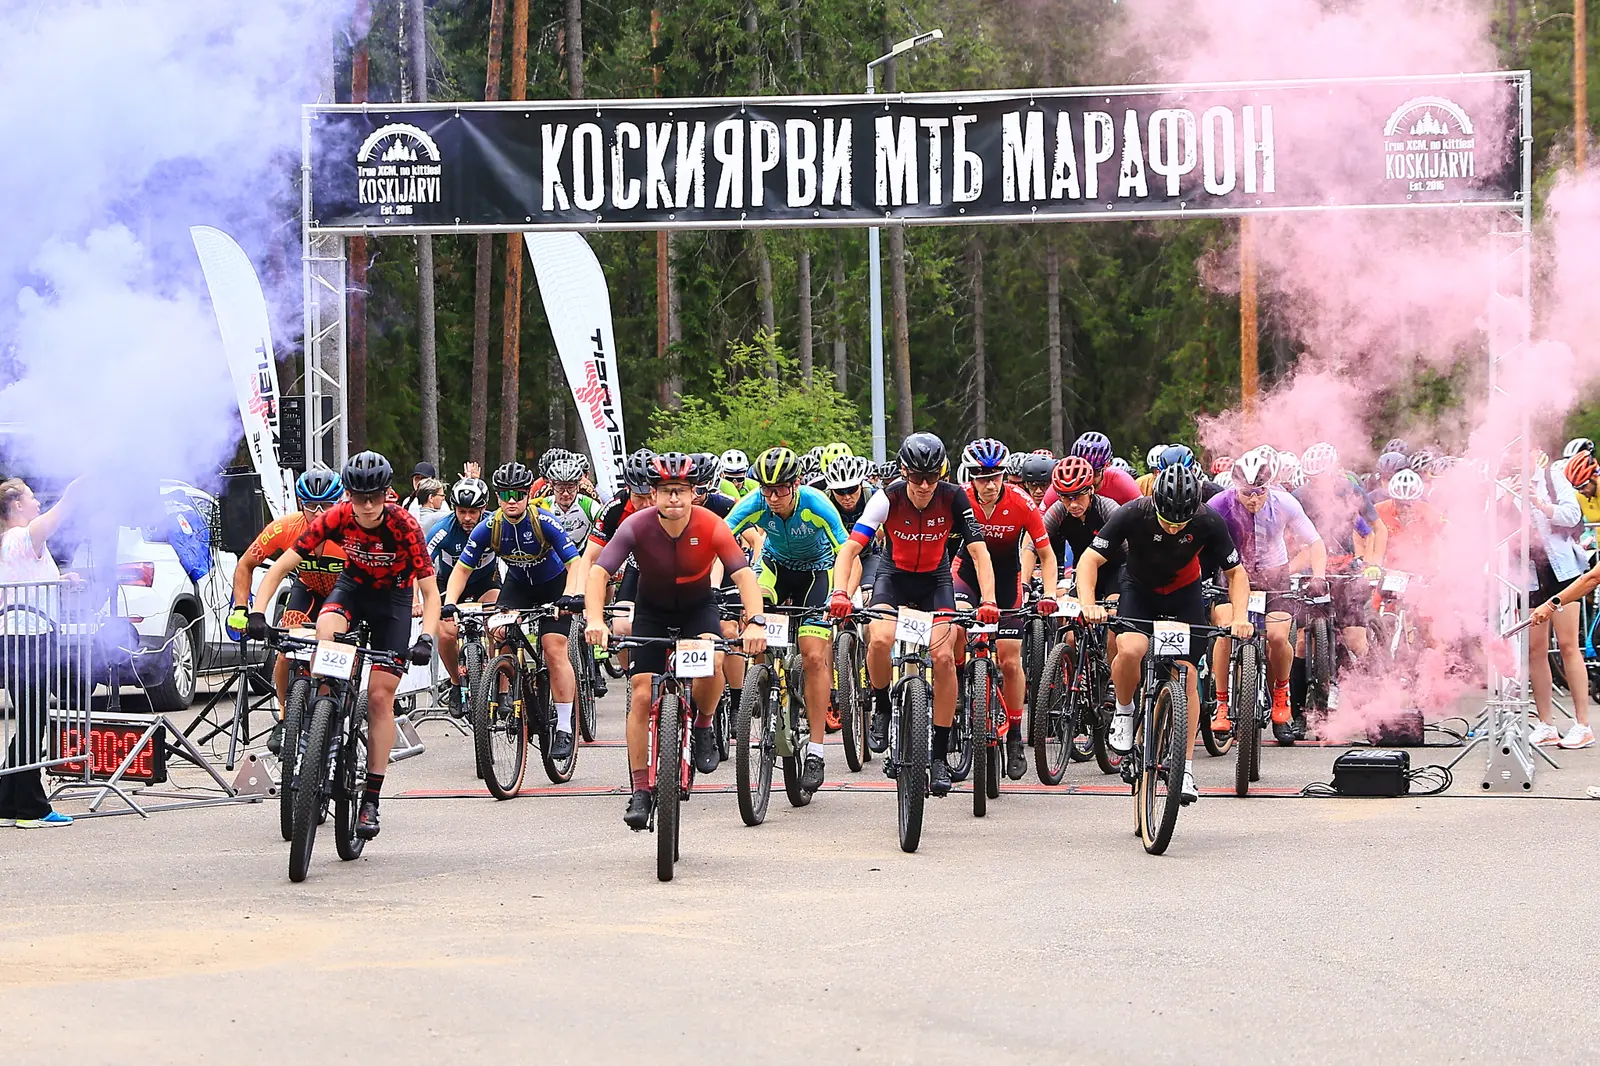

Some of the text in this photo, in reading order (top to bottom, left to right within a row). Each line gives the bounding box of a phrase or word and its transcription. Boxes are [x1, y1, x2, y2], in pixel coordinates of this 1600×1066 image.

[1430, 140, 1441, 151] no
[541, 104, 1276, 211] КОСКИЯРВИ МТБ МАРАФОН
[1385, 149, 1475, 180] KOSKIJÄRVI
[400, 166, 411, 176] no
[358, 175, 441, 204] KOSKIJÄRVI
[980, 524, 1015, 532] PORTS
[903, 618, 926, 633] 203
[1160, 631, 1185, 643] 326
[321, 650, 348, 666] 328
[682, 651, 707, 664] 204
